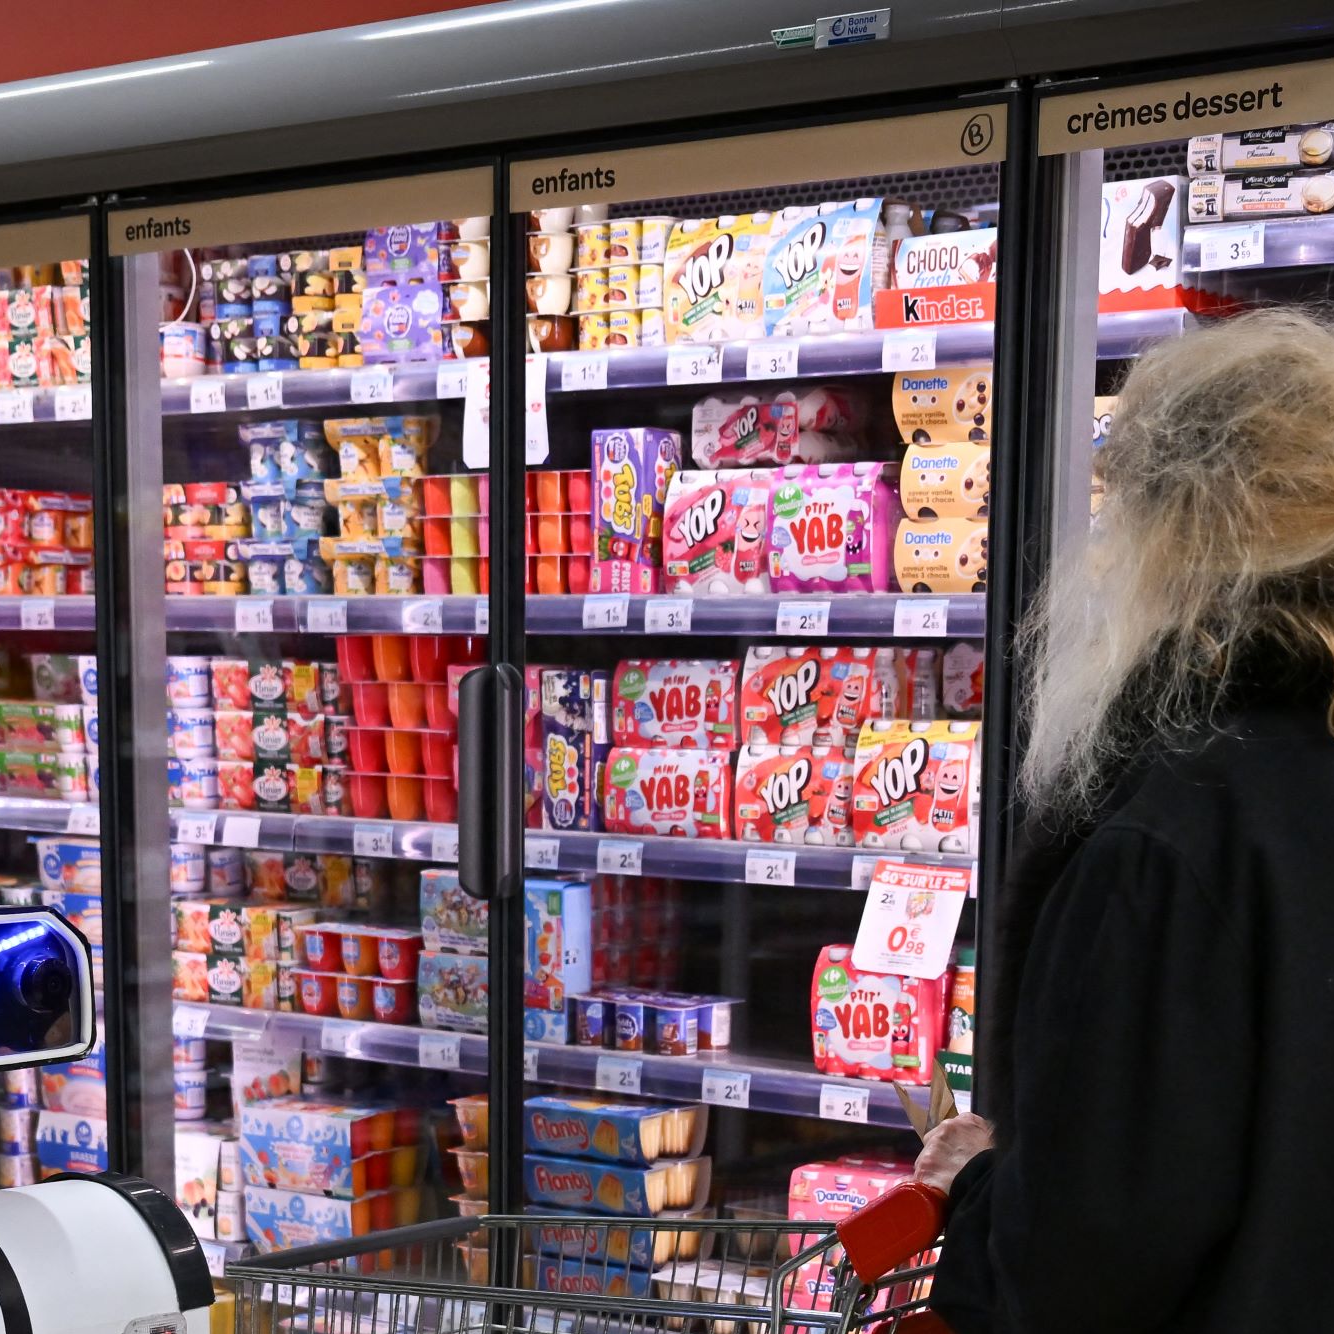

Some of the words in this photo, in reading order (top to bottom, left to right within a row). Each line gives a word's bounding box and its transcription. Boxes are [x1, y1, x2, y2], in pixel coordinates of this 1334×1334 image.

[848, 14, 877, 26] Bonnet
[1066, 101, 1166, 135] crèmes
[1172, 82, 1283, 120] dessert
[532, 167, 616, 195] enfants
[125, 216, 191, 241] enfants
[679, 233, 734, 304] YOP
[774, 222, 827, 288] YOP
[907, 243, 958, 275] CHOCO
[903, 294, 981, 325] kinder
[902, 378, 947, 391] Danette
[733, 404, 757, 439] YOP
[911, 456, 958, 470] Danette
[678, 489, 724, 549] YOP
[790, 514, 844, 556] YAB
[904, 531, 952, 545] Danette
[649, 684, 701, 720] YAB
[767, 658, 820, 717] YOP
[870, 737, 929, 808] YOP
[639, 775, 690, 811] YAB
[901, 871, 925, 887] SUR
[926, 873, 940, 888] LE
[834, 1001, 889, 1040] YAB
[531, 1112, 590, 1150] Flanby
[535, 1165, 593, 1203] Flanby
[816, 1189, 867, 1207] Danonino
